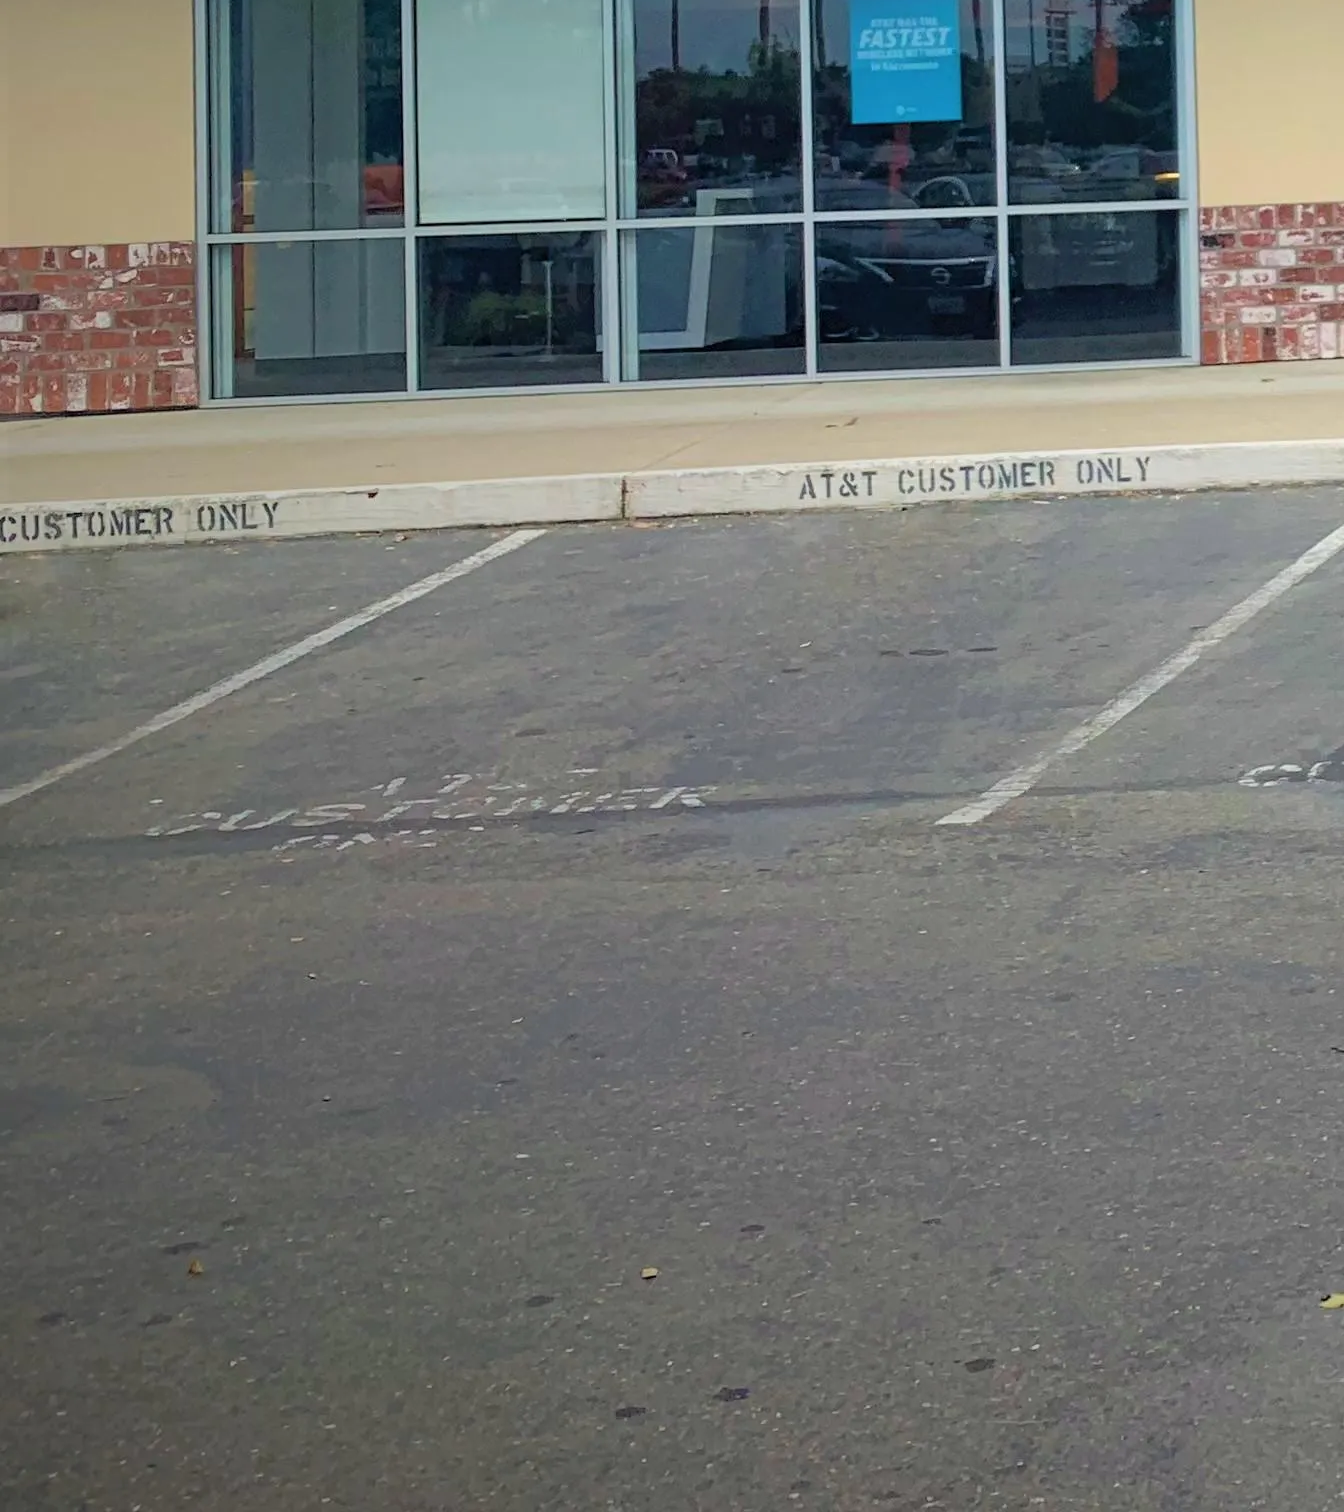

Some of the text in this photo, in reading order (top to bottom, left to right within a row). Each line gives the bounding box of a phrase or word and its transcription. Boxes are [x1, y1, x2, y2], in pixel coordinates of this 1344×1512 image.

[859, 26, 952, 49] FASTEST
[799, 456, 1151, 500] AT&T CUSTOMER ONLY
[0, 501, 279, 543] CUSTOMER ONLY
